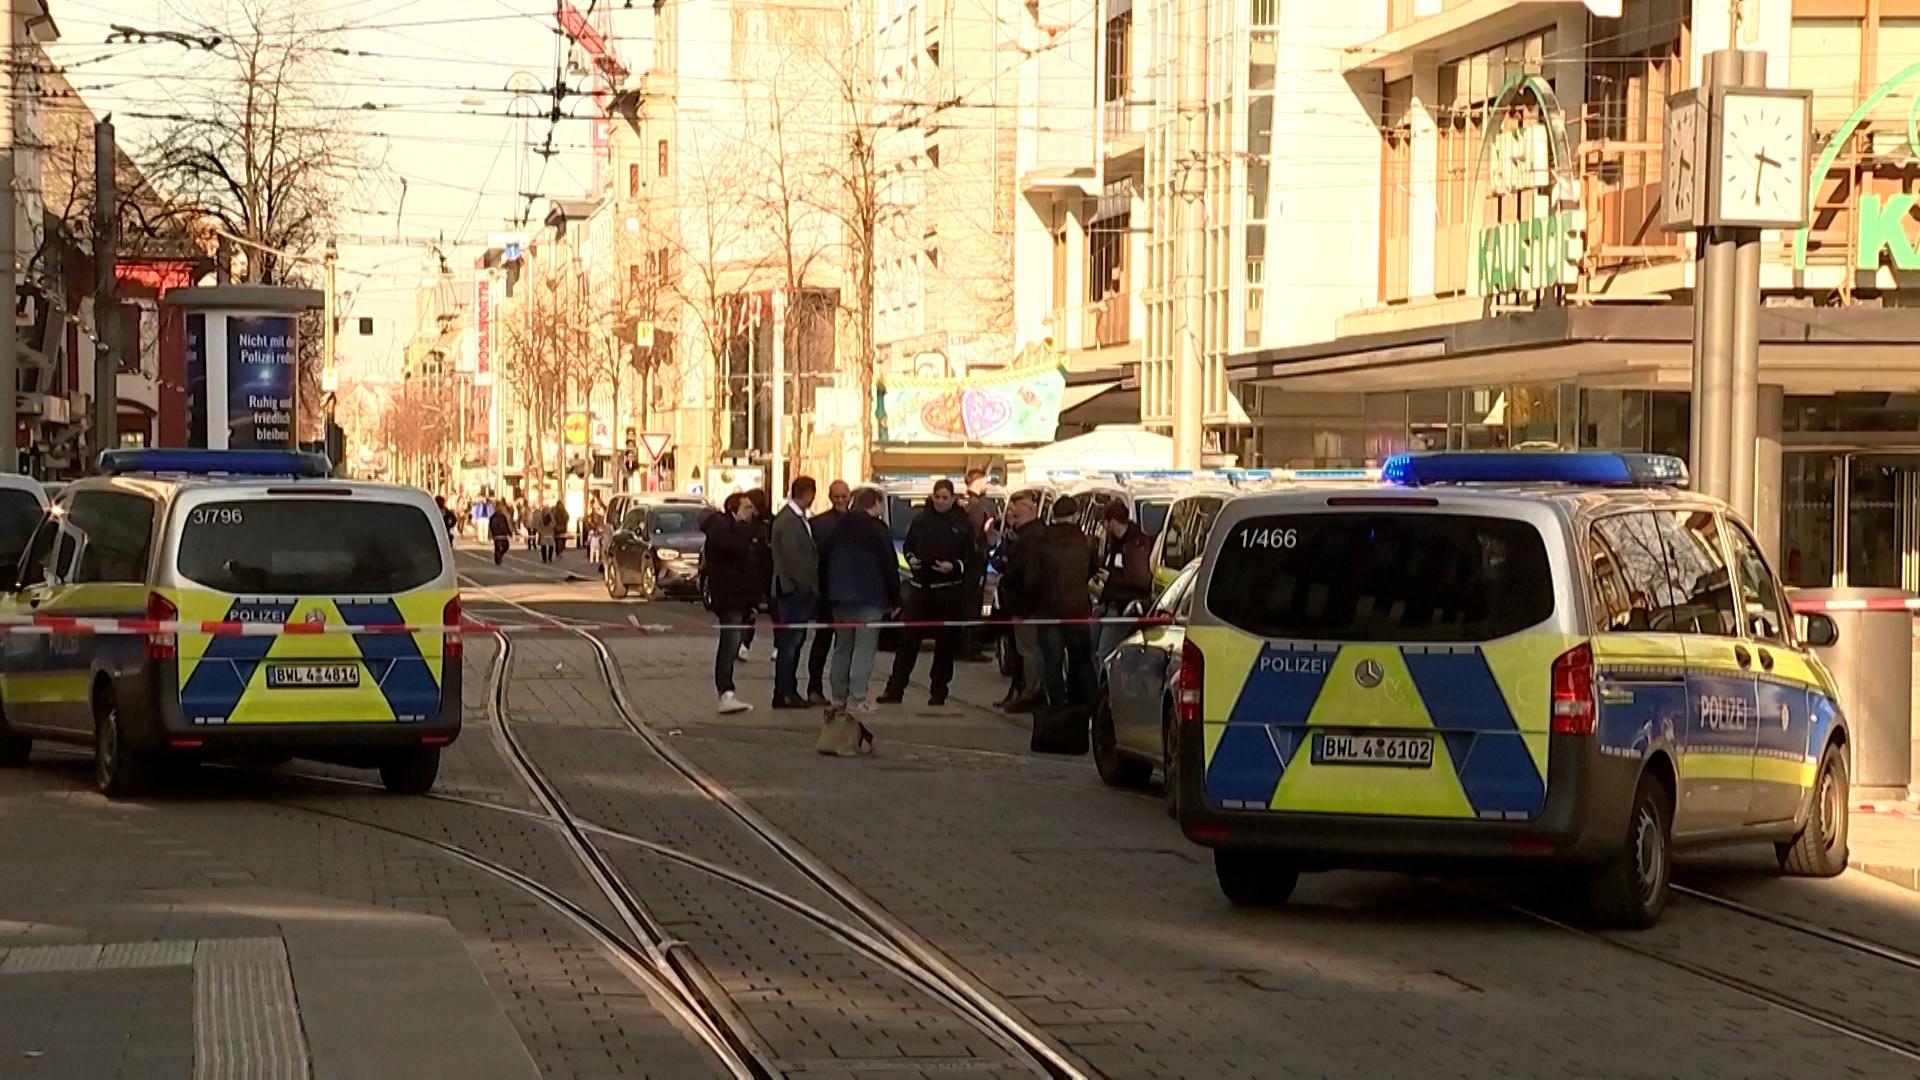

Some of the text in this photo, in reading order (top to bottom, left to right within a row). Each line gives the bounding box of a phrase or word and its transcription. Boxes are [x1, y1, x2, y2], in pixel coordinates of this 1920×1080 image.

[1859, 194, 1920, 270] K
[239, 333, 267, 347] Nicht
[270, 335, 285, 348] mit
[241, 349, 275, 364] Polizei
[249, 395, 278, 411] Ruhig
[254, 410, 291, 424] friedlich
[193, 508, 243, 524] 3/796
[1239, 528, 1297, 548] 1/466
[230, 609, 286, 622] POLIZEI
[1260, 656, 1327, 674] POLIZEI
[277, 668, 356, 682] BWL 4 4814
[1701, 695, 1747, 730] POLIZEI
[1325, 738, 1429, 760] BWL 4 6102
